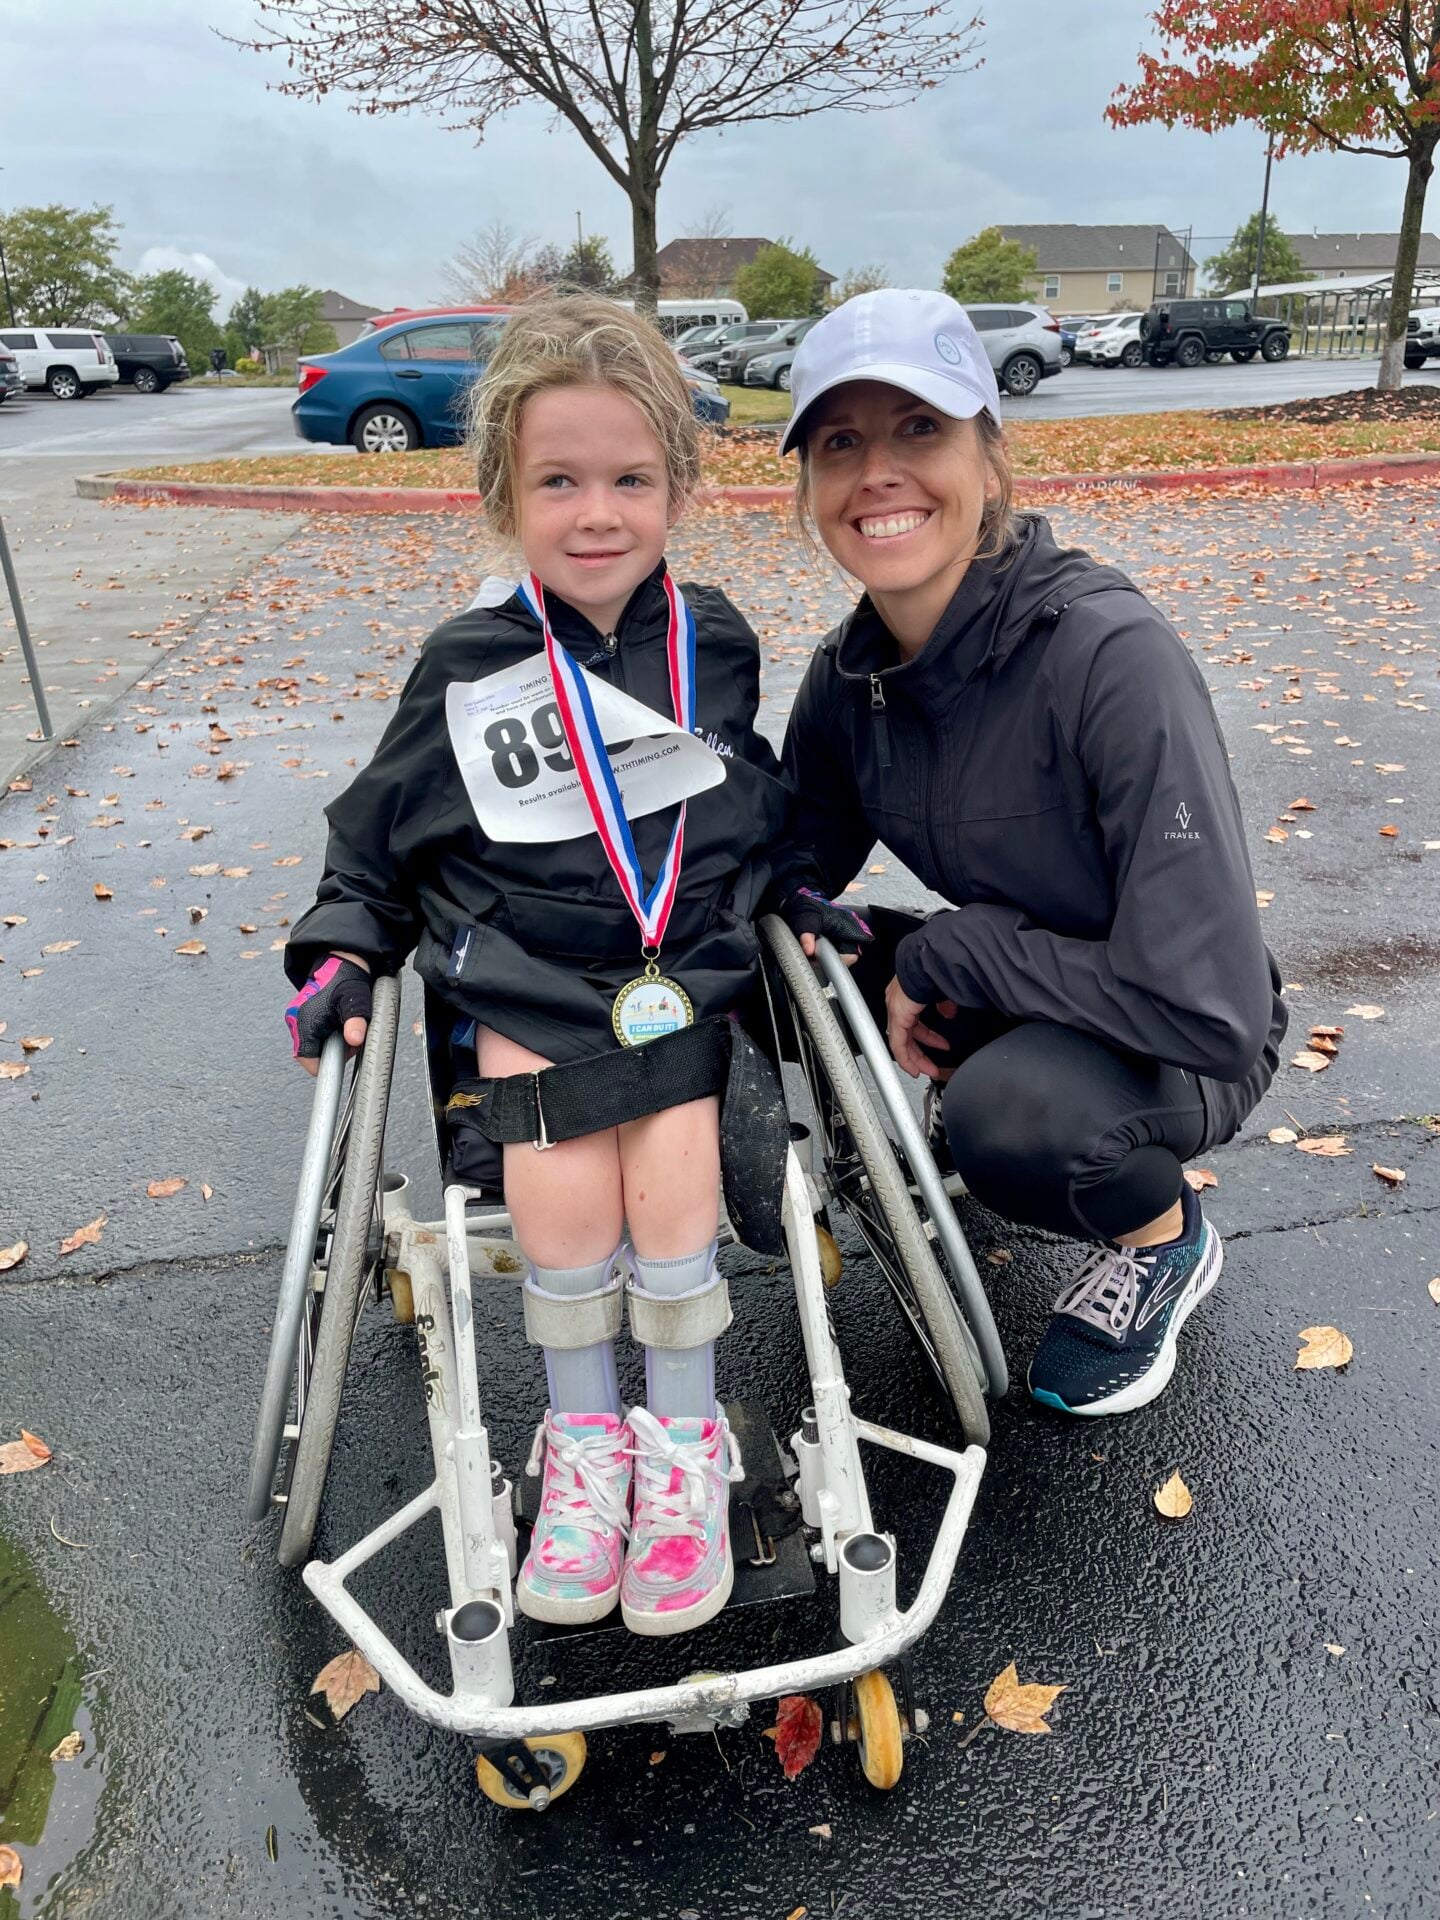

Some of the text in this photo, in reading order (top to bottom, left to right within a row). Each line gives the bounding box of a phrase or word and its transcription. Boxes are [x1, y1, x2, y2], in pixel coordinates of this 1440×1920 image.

[519, 676, 548, 692] TIMING
[518, 794, 547, 807] Results
[1163, 831, 1201, 840] TRAVEX
[636, 1024, 653, 1033] CAN
